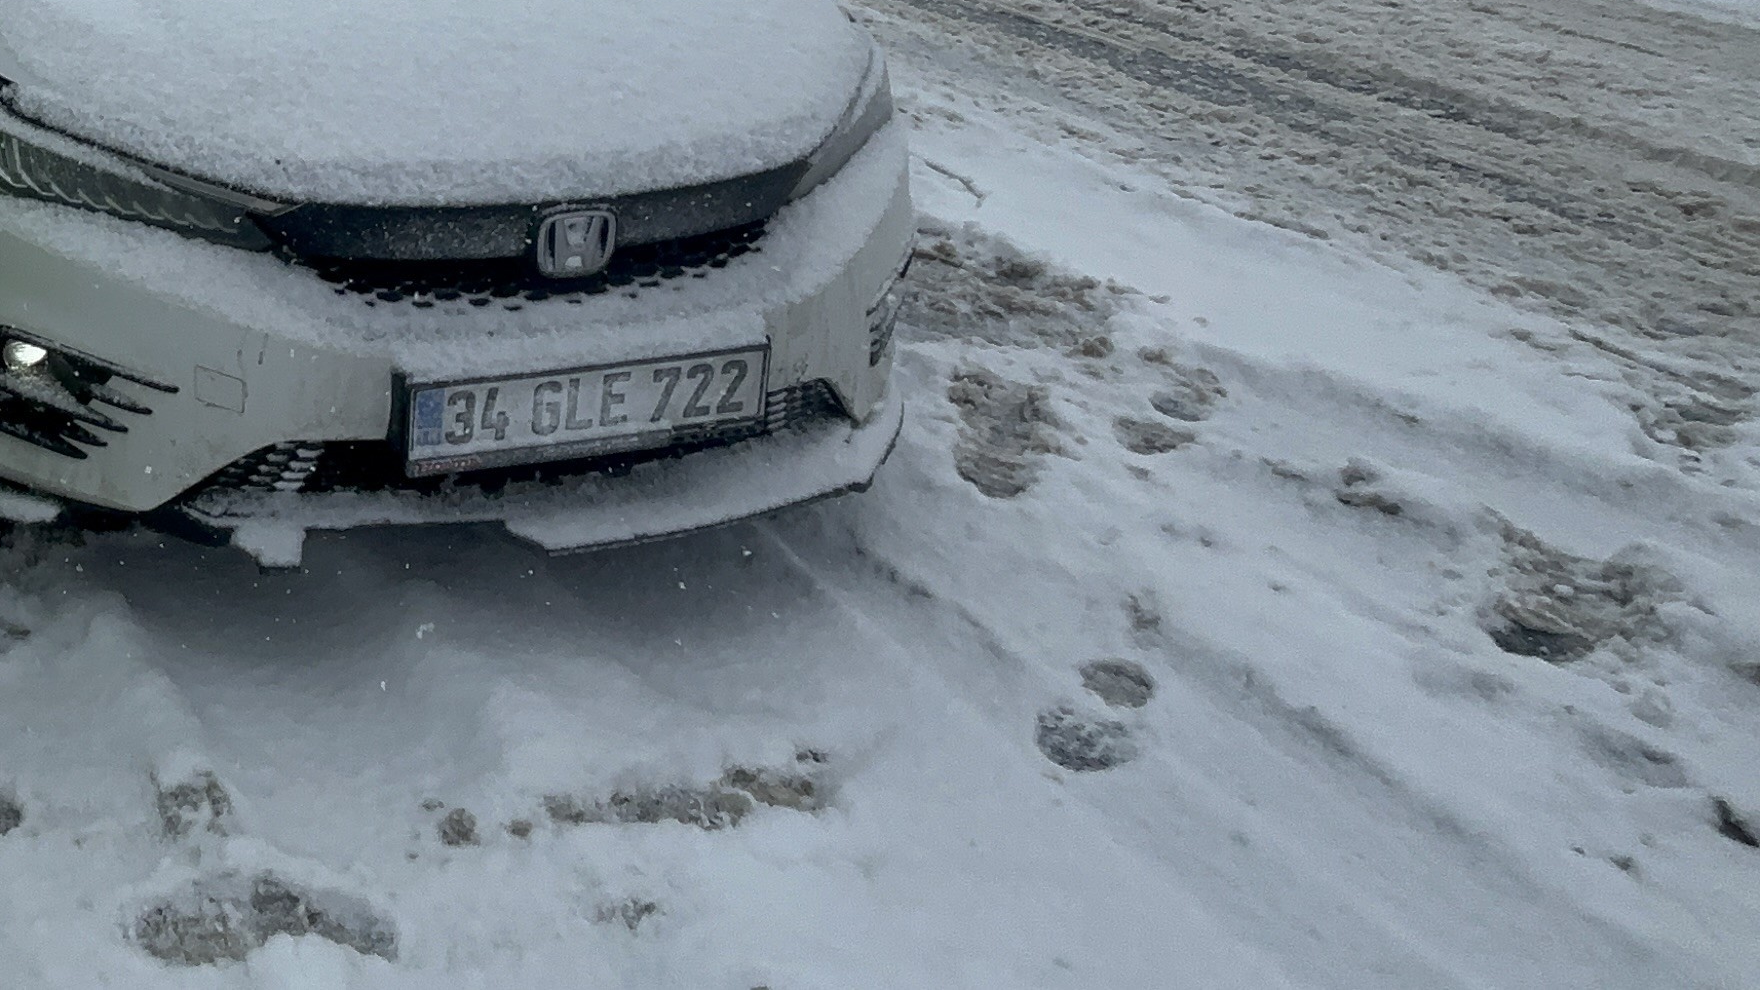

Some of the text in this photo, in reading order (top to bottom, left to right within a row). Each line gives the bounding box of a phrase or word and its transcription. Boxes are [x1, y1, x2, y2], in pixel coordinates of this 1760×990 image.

[444, 359, 749, 446] 34 GLE 722
